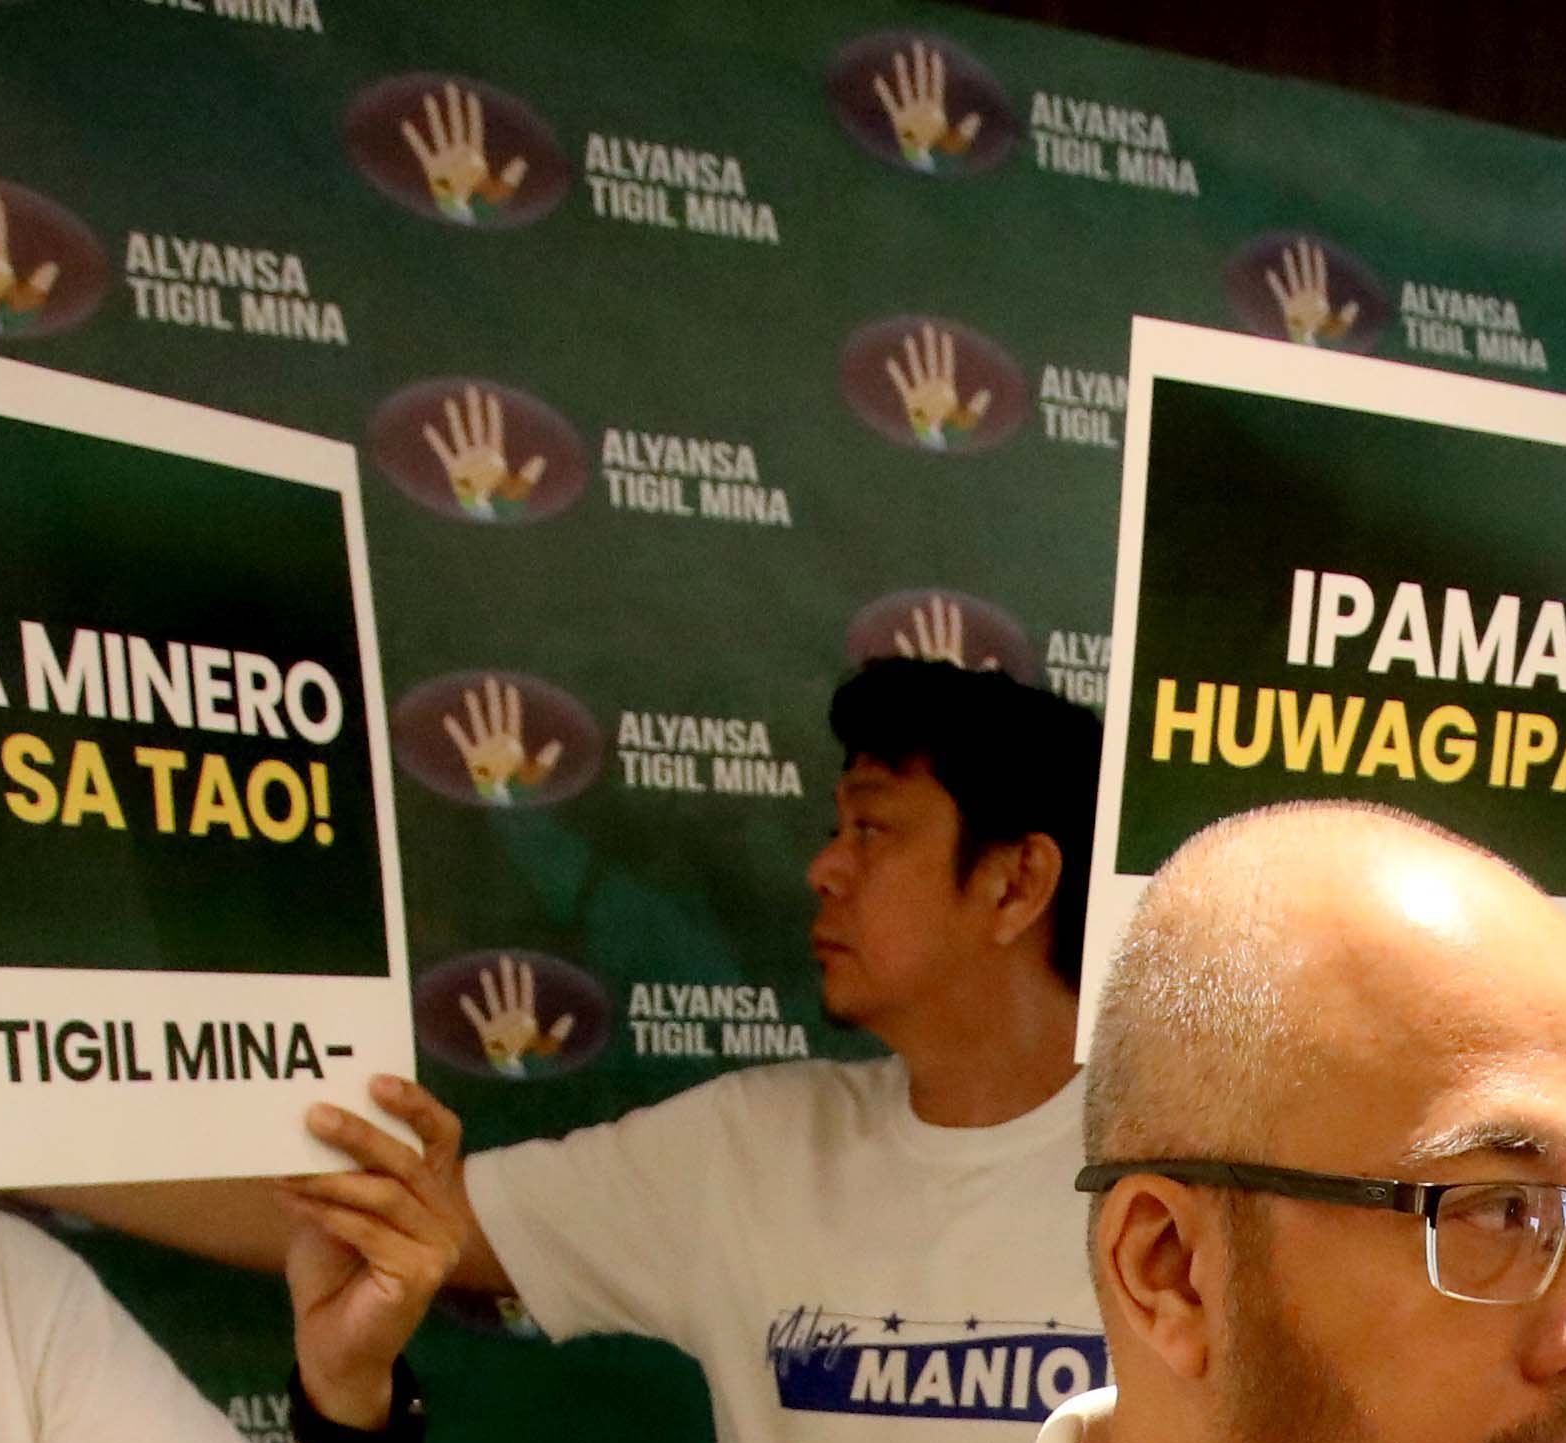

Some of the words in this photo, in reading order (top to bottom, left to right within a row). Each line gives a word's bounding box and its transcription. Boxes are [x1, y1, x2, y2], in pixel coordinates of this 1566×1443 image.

[1032, 92, 1170, 153] ALYANSA
[585, 132, 745, 196] ALYANSA
[1033, 134, 1111, 180] TIGIL
[1118, 149, 1199, 197] MINA
[587, 176, 677, 229] TIGIL
[684, 191, 779, 244] MINA
[126, 231, 309, 296] ALYANSA
[126, 276, 233, 331] TIGIL
[239, 294, 349, 345] MINA
[1399, 281, 1522, 333] ALYANSA
[1406, 317, 1472, 356] TIGIL
[1475, 331, 1548, 372] MINA
[601, 428, 759, 483] ALYANSA
[604, 469, 692, 516] TIGIL
[699, 480, 792, 528] MINA
[20, 618, 344, 745] MINERO
[618, 711, 771, 756] ALYANSA
[1151, 677, 1478, 783] HUWAG
[2, 732, 126, 830] SA
[135, 745, 336, 845] TAO!
[619, 750, 704, 793] TIGIL
[713, 755, 804, 797] MINA
[629, 983, 779, 1021] ALYANSA
[166, 1019, 355, 1082] MINA-
[630, 1019, 714, 1058] TIGIL
[721, 1023, 809, 1058] MINA
